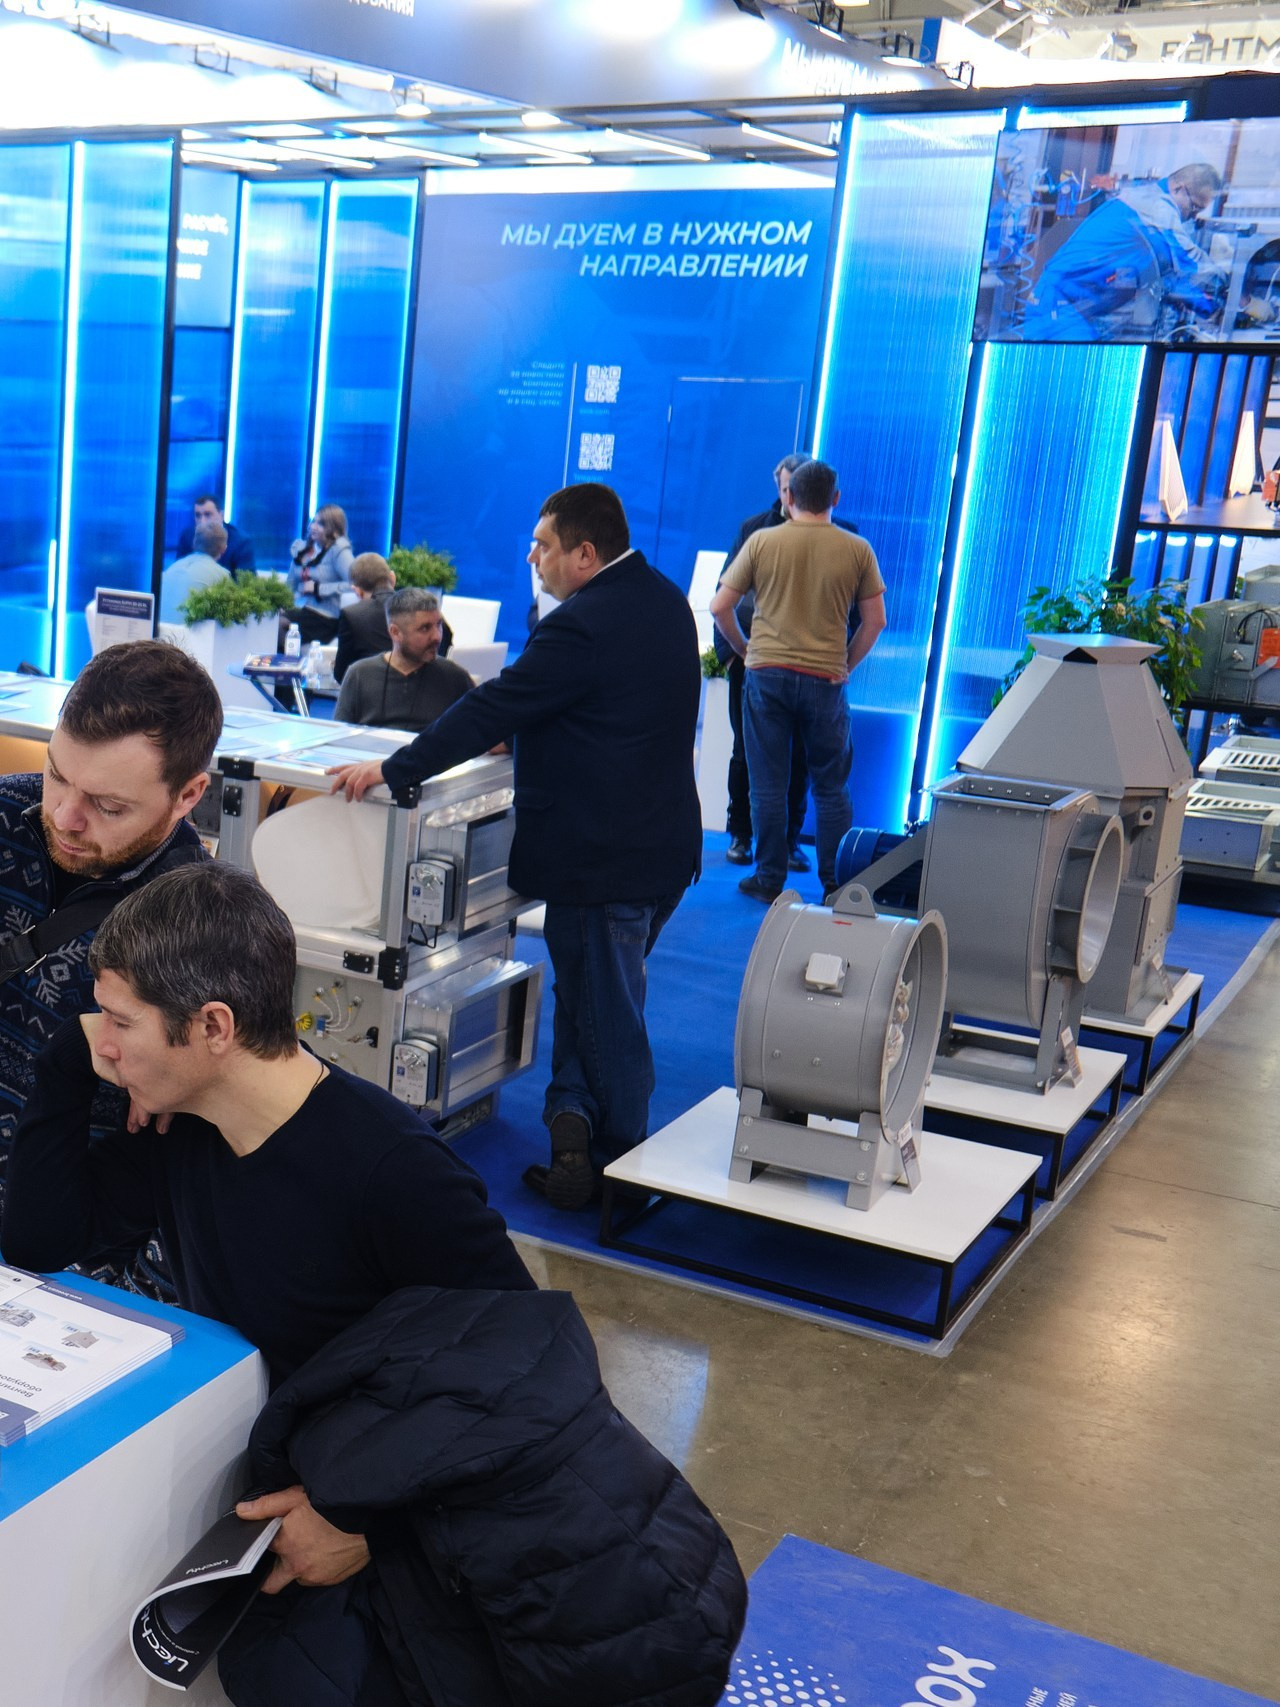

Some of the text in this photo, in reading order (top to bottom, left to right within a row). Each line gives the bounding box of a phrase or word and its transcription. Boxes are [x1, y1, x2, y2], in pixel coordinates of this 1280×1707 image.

[501, 220, 813, 249] МЫ ДУЕМ В НУЖНОМ
[579, 253, 809, 278] НАПРАВЛЕНИИ
